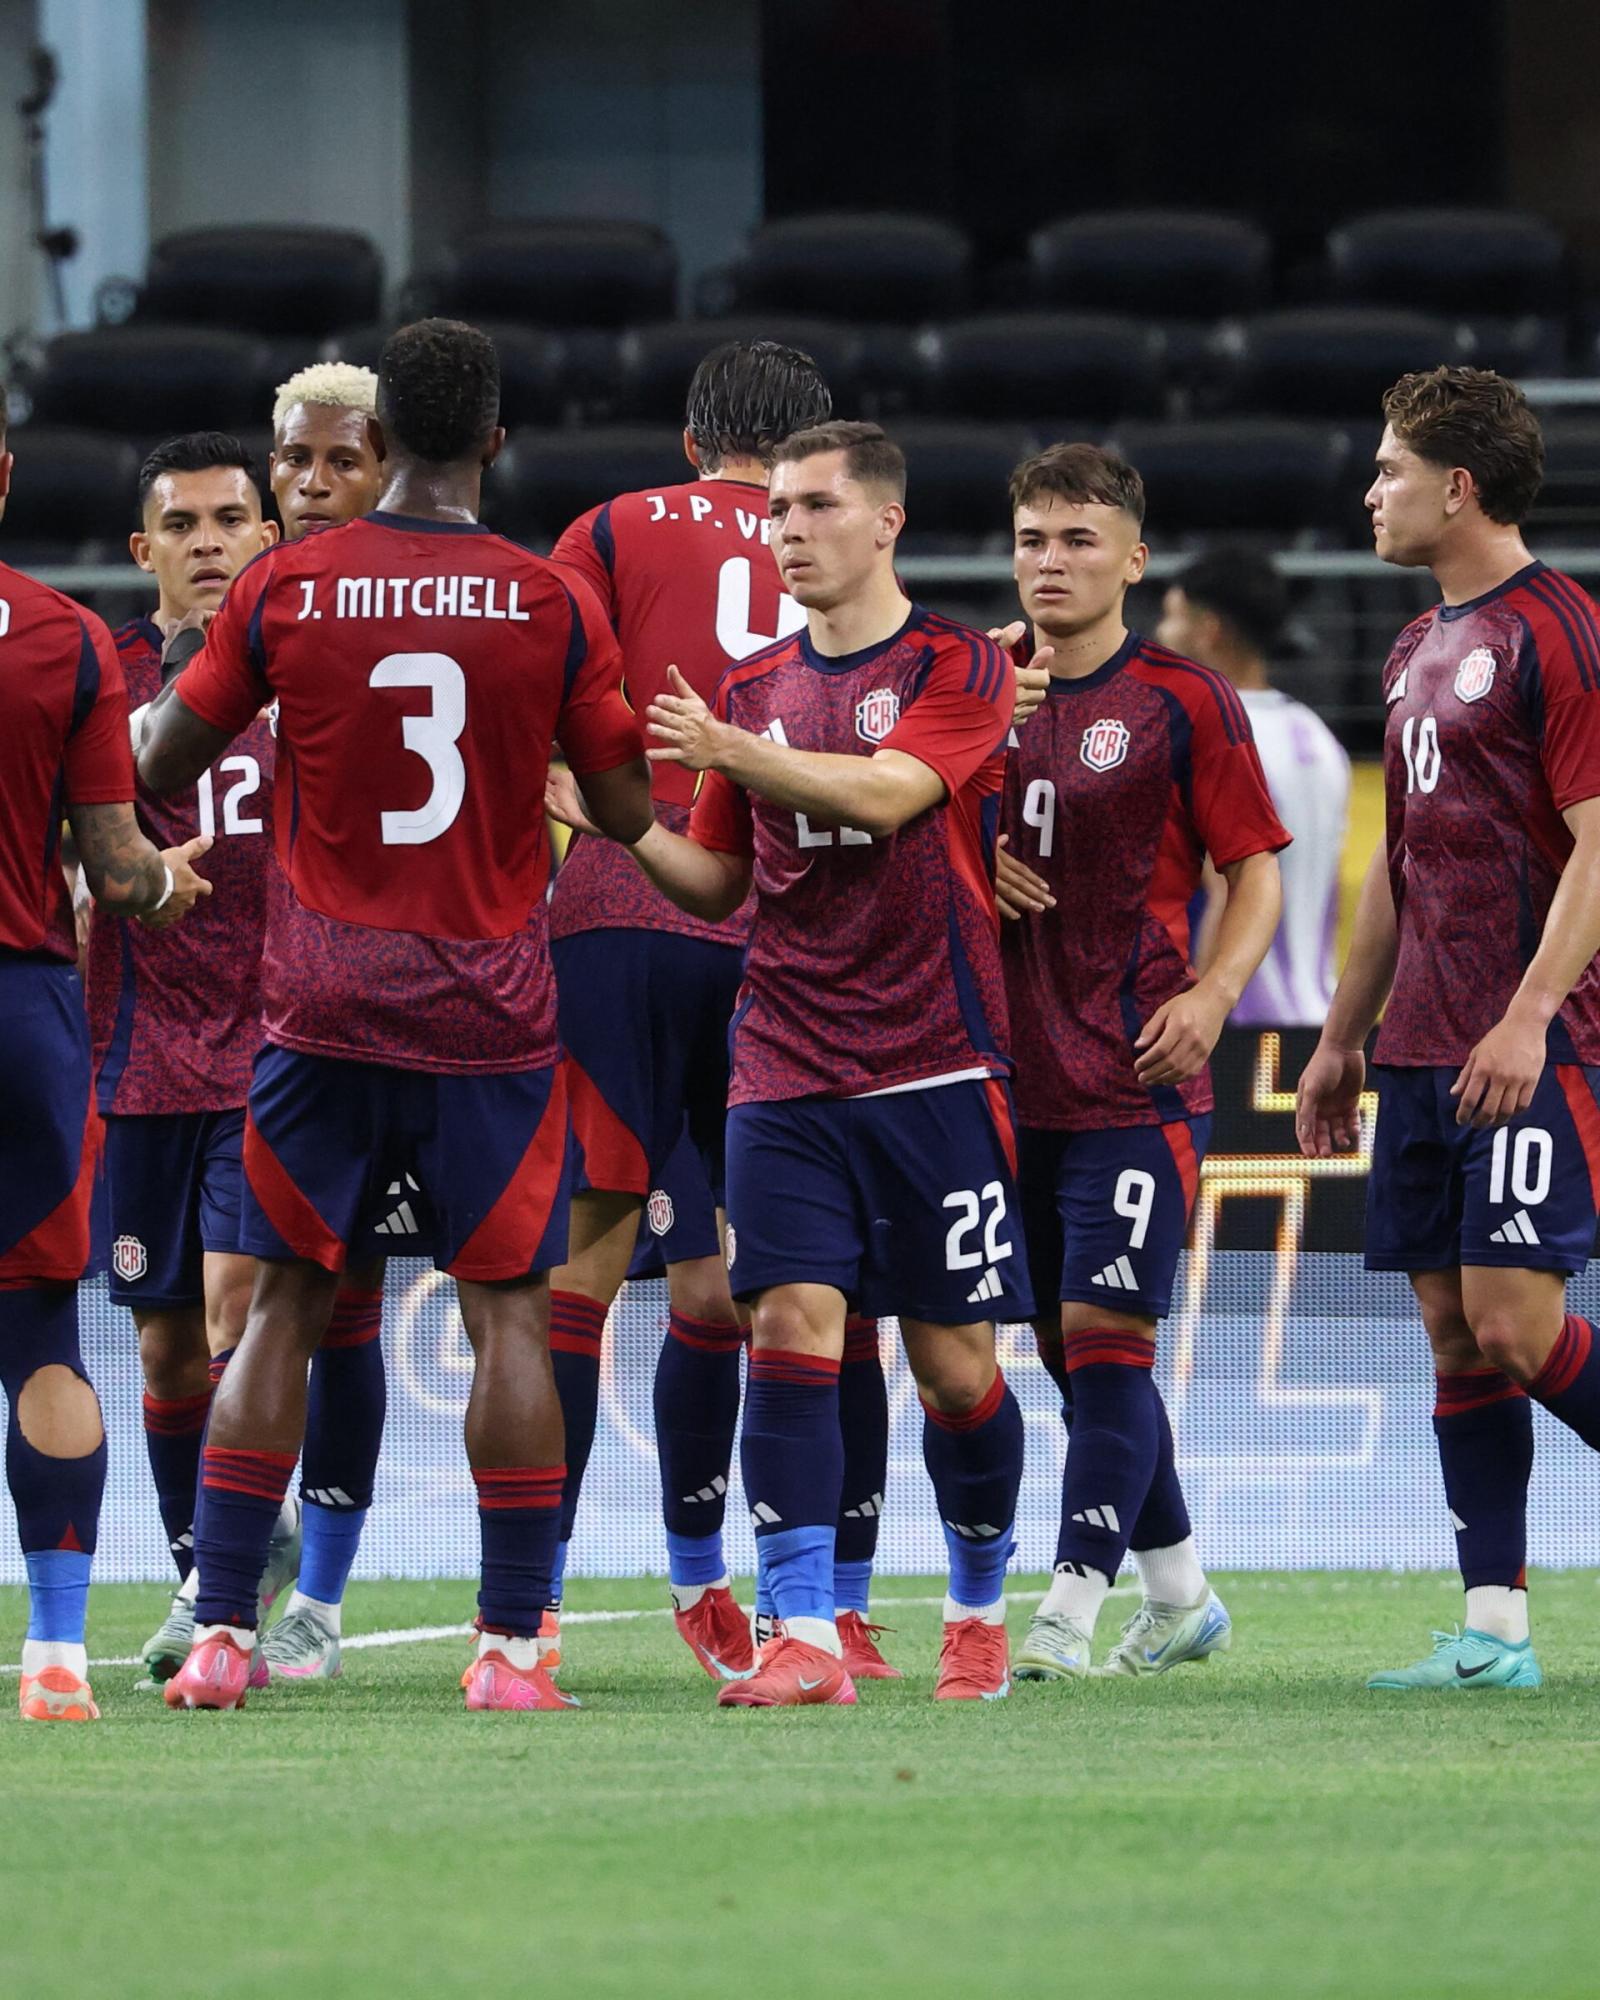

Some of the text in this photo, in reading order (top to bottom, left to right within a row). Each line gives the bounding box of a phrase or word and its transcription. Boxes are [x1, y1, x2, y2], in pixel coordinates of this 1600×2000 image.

[645, 495, 680, 522] J.
[689, 494, 724, 529] P.
[297, 575, 530, 621] J. MITCHELL
[368, 652, 466, 845] 3
[868, 701, 892, 734] CR
[1091, 730, 1119, 761] CR
[1402, 716, 1442, 794] 10
[197, 755, 263, 837] 12
[1022, 778, 1056, 857] 9
[1489, 1126, 1553, 1206] 10
[942, 1180, 1013, 1271] 22
[1113, 1168, 1156, 1250] 9
[121, 1244, 139, 1271] CR
